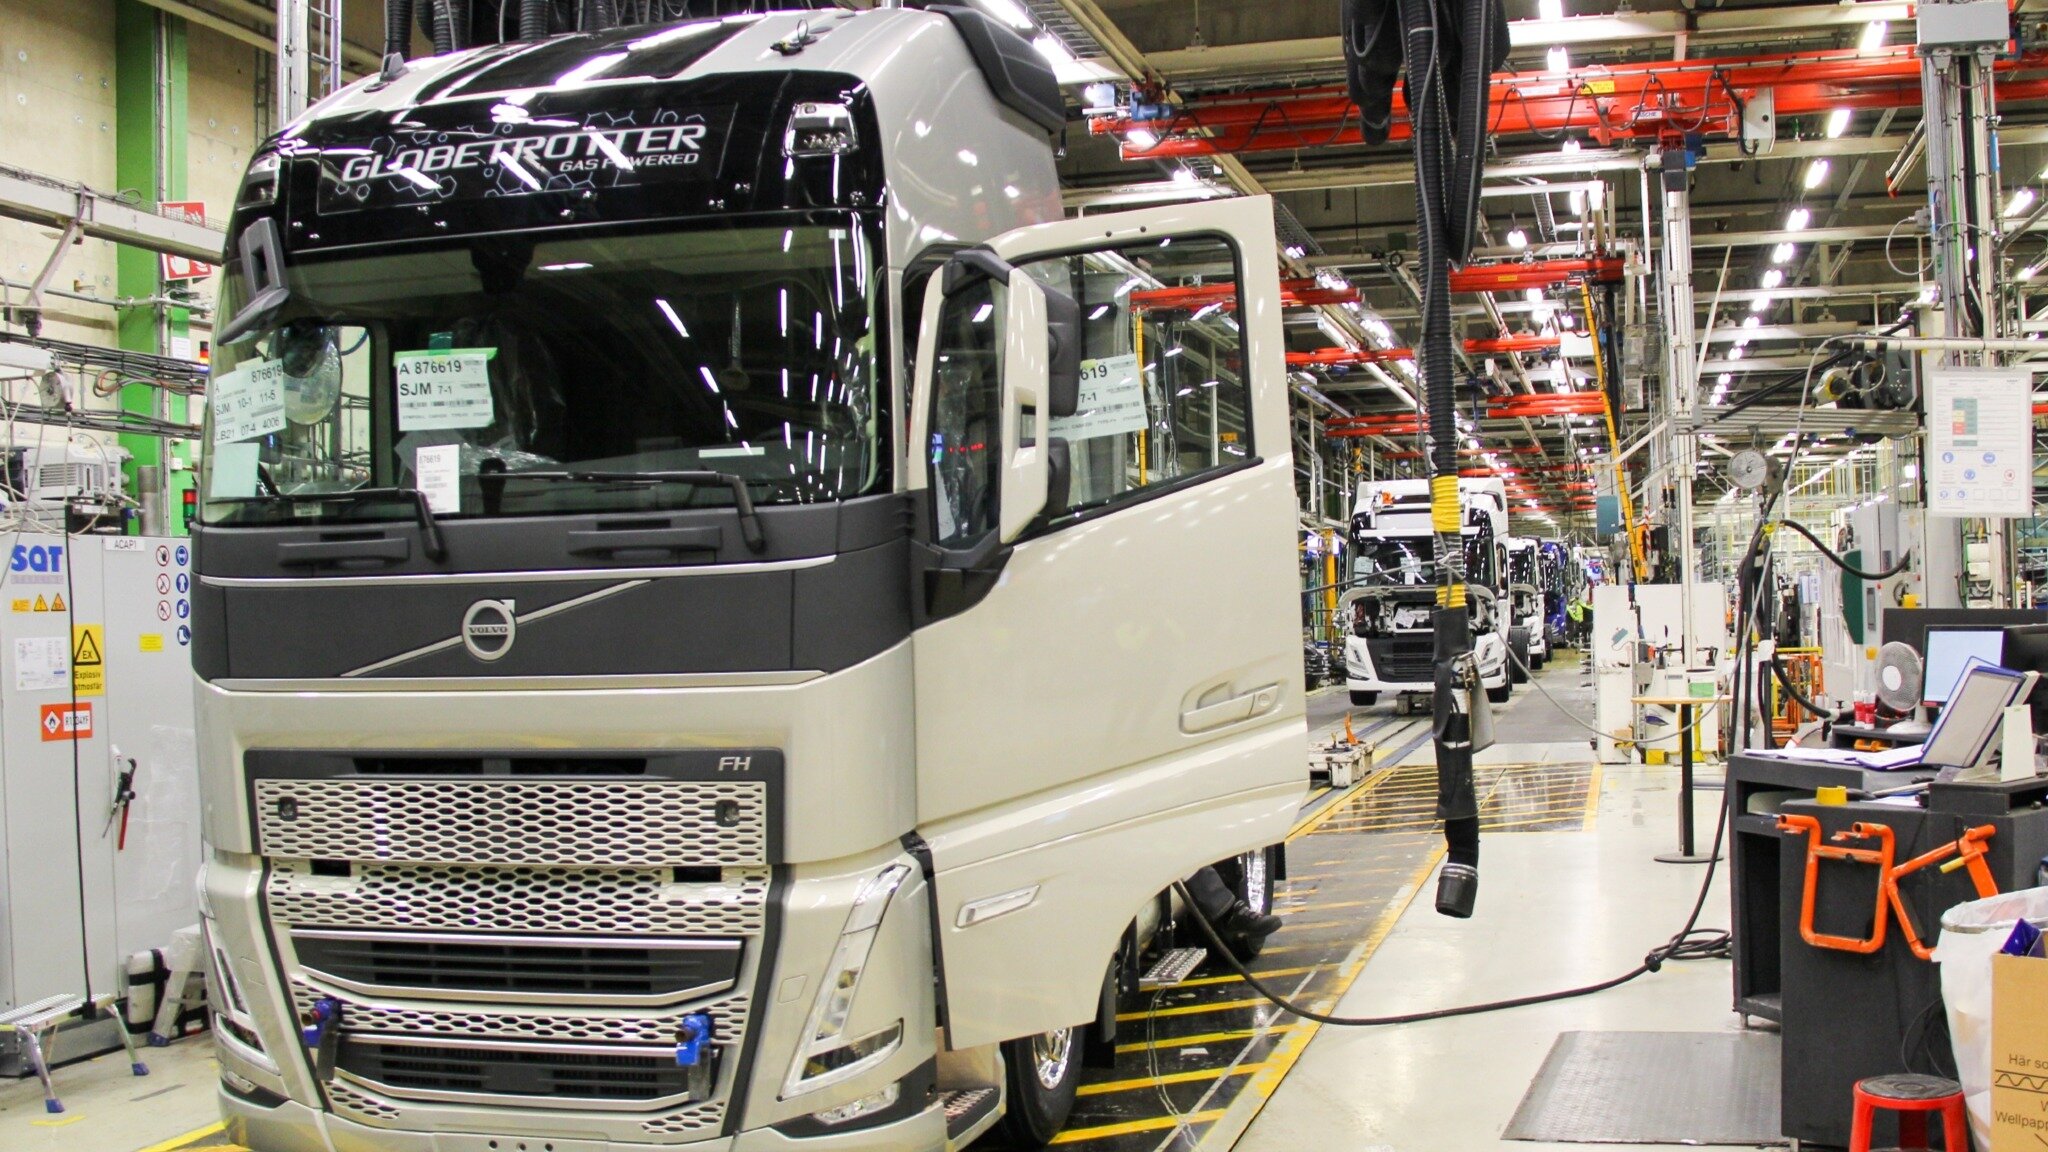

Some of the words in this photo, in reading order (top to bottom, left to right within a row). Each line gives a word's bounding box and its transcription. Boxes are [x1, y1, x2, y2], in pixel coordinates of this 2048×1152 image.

[342, 124, 706, 183] GLOBETROTTER
[559, 158, 600, 173] GAS
[601, 152, 699, 169] PWERED
[251, 365, 282, 383] 876619
[399, 363, 410, 375] A
[415, 360, 462, 374] 876619
[400, 382, 432, 396] SJM
[438, 385, 452, 394] 7-1
[216, 403, 230, 416] SJM
[238, 397, 252, 409] 10-1
[260, 389, 276, 403] 11-5
[1080, 392, 1097, 403] 7-1
[468, 626, 508, 634] VOLVO
[82, 650, 93, 660] EX
[65, 715, 89, 726] R134YF
[718, 756, 751, 771] FH
[2008, 1053, 2031, 1067] Här
